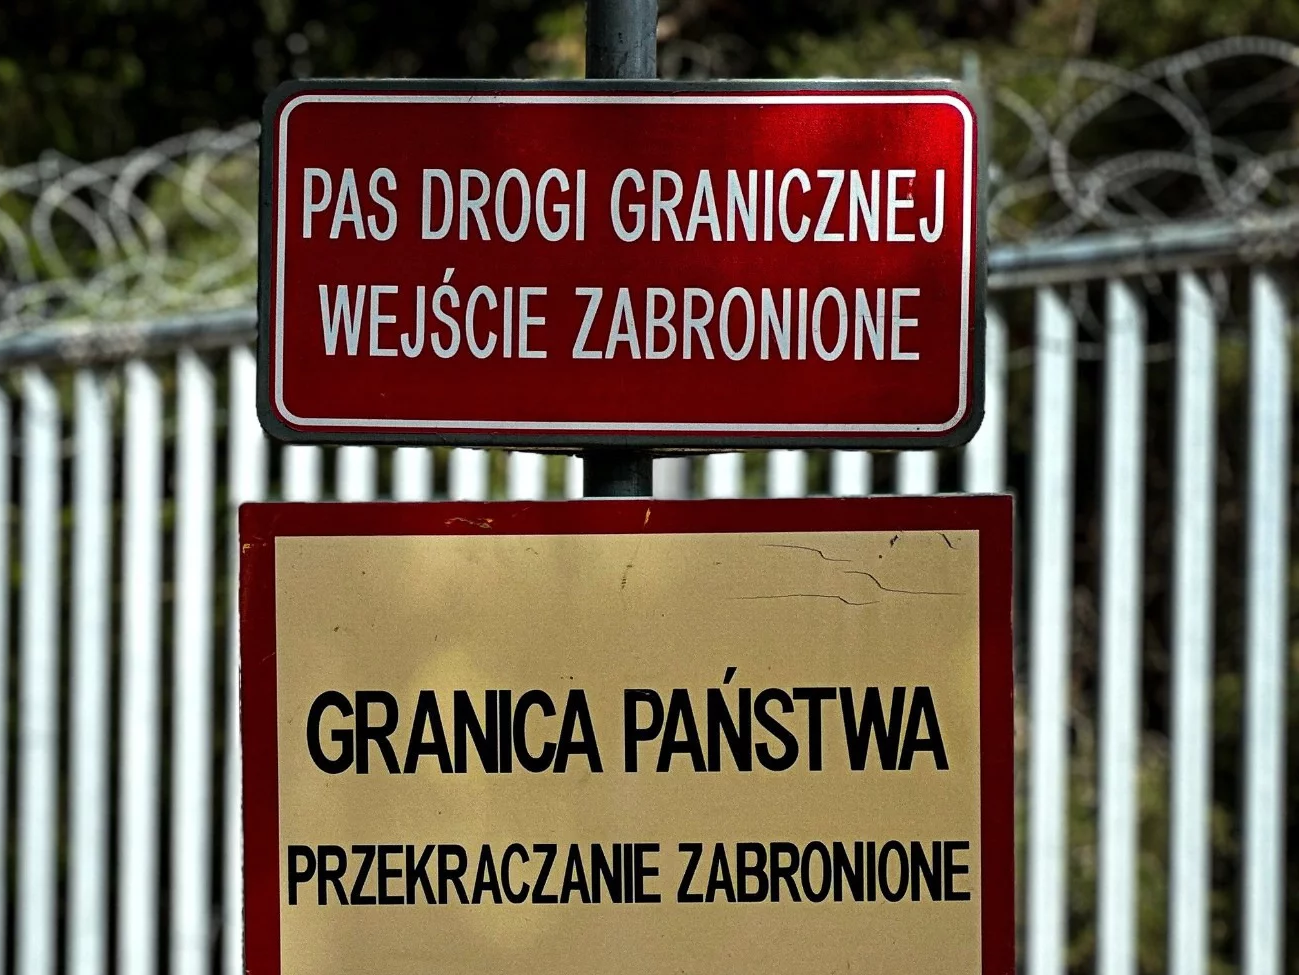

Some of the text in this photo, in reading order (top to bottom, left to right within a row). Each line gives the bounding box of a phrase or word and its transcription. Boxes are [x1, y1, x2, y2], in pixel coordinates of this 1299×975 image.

[302, 166, 946, 244] PAS DROGI GRANICZNEJ
[318, 267, 920, 362] WEJŚCIE ZABRONIONE
[305, 666, 950, 775] GRANICA PAŃSTWA
[287, 839, 972, 906] PRZEKRACZANIE ZABRONIONE
